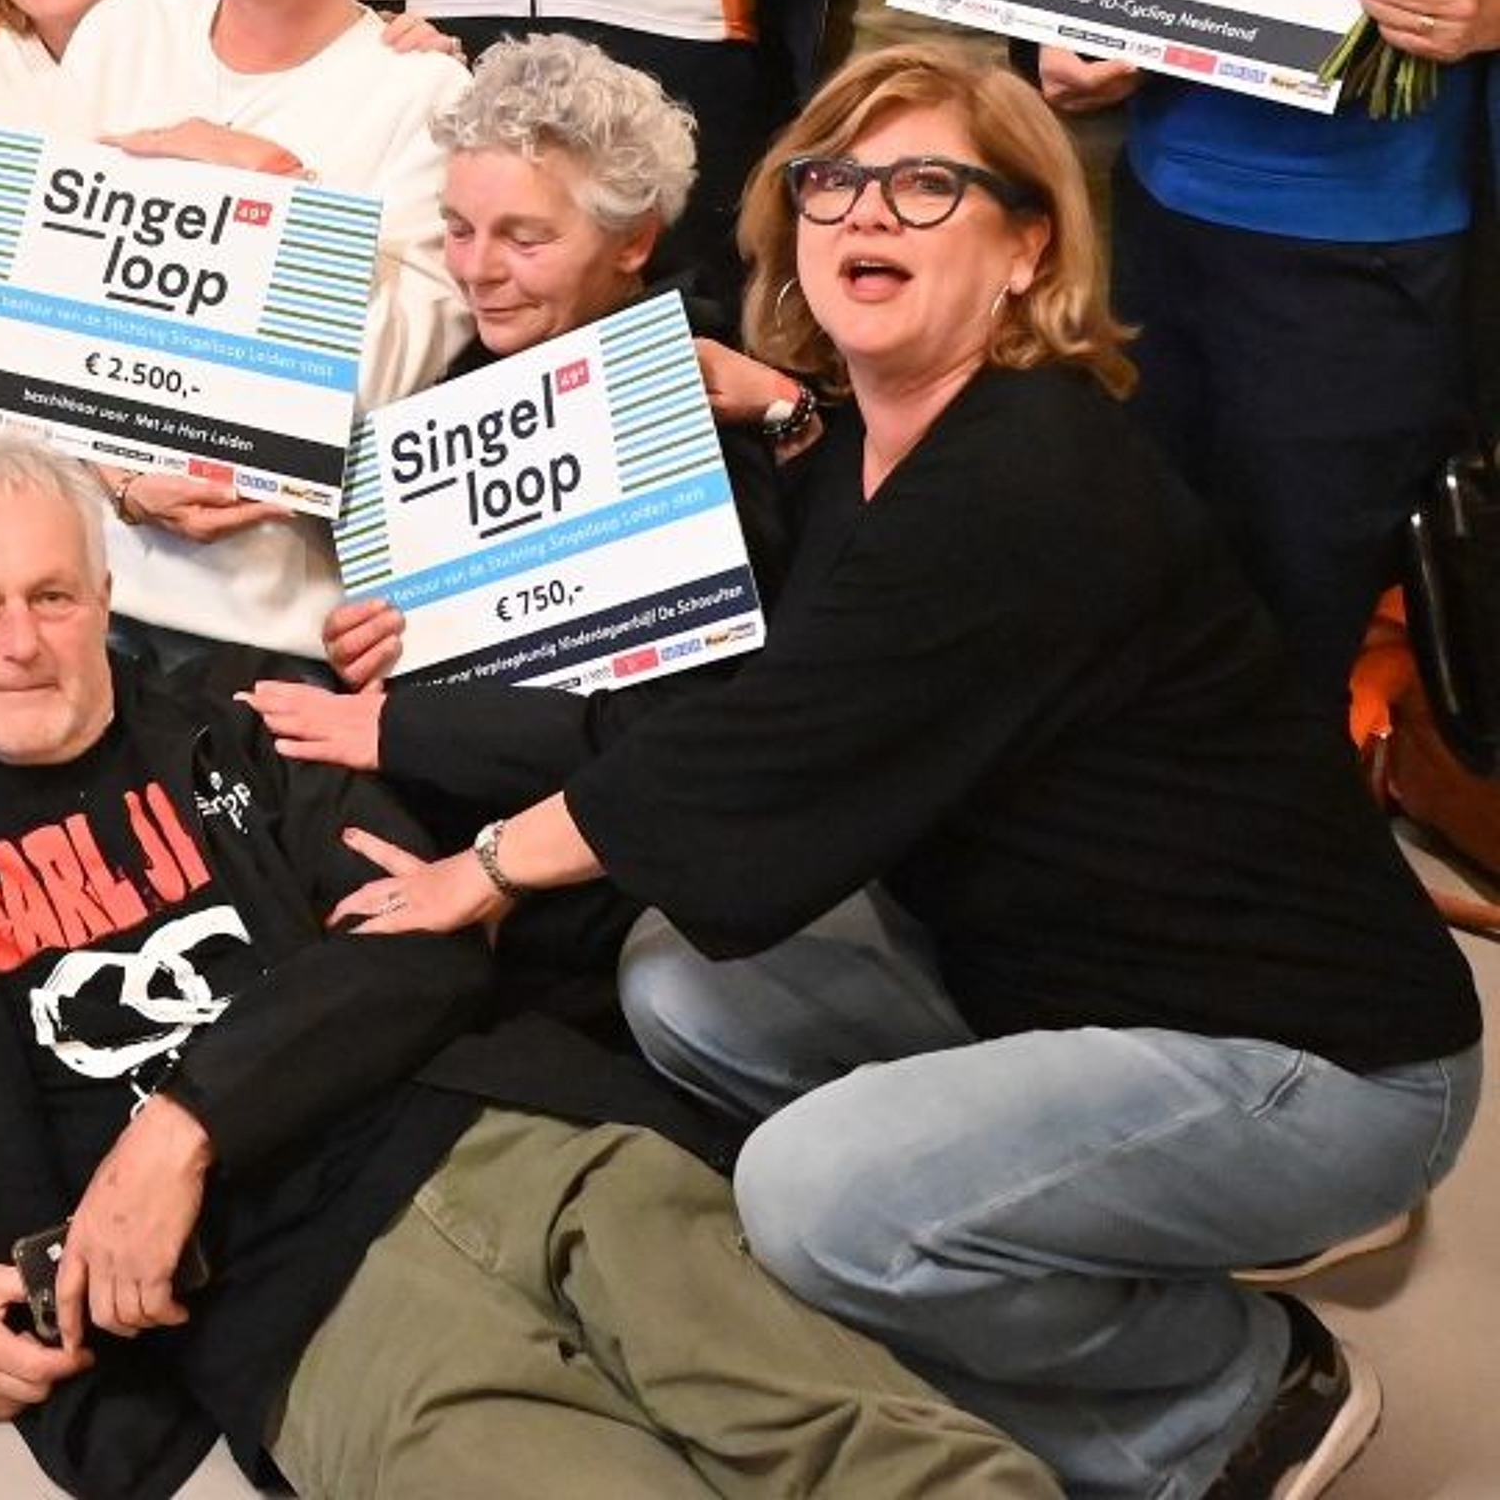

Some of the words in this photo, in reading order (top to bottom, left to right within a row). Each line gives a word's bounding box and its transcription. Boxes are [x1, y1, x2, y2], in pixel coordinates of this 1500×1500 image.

[1177, 10, 1259, 41] Nederland
[44, 168, 232, 247] Singel
[103, 236, 228, 315] loop
[84, 350, 100, 376] €
[106, 355, 202, 401] 2.500,-
[392, 372, 555, 484] Singel
[467, 453, 581, 525] loop
[494, 594, 514, 624] €
[515, 570, 586, 621] 750,-
[655, 600, 678, 620] De
